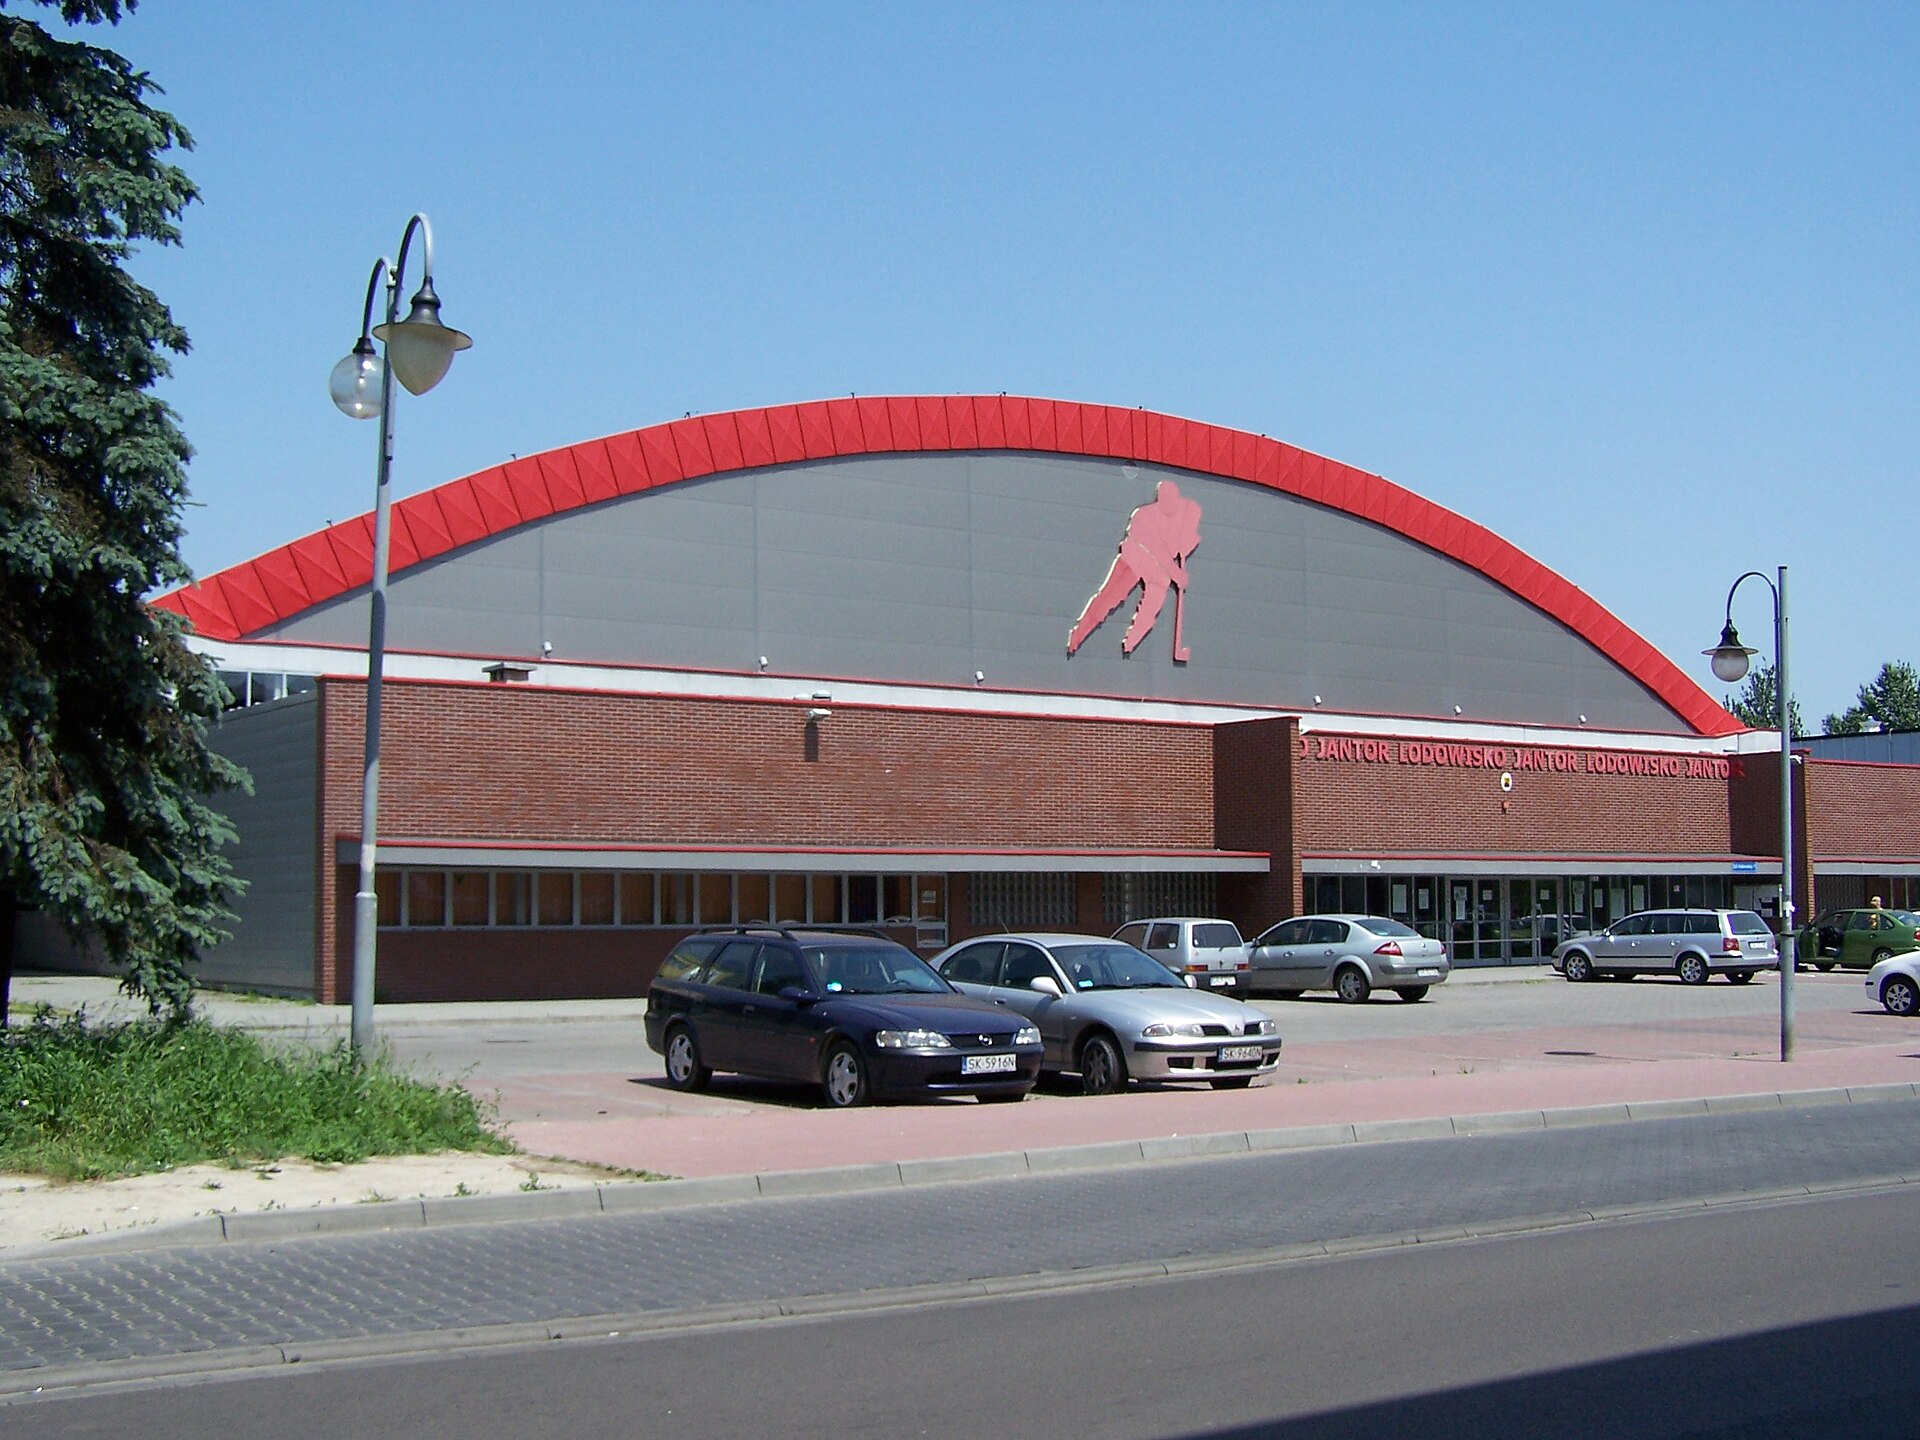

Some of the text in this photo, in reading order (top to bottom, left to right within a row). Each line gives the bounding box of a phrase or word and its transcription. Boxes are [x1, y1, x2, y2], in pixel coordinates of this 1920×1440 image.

[1316, 737, 1390, 763] JANTOR
[1398, 742, 1507, 769] LODOWISKO
[1512, 749, 1578, 773] JANTOR
[1586, 753, 1680, 778] LODOWISKO
[968, 1056, 1015, 1070] SK 5916N
